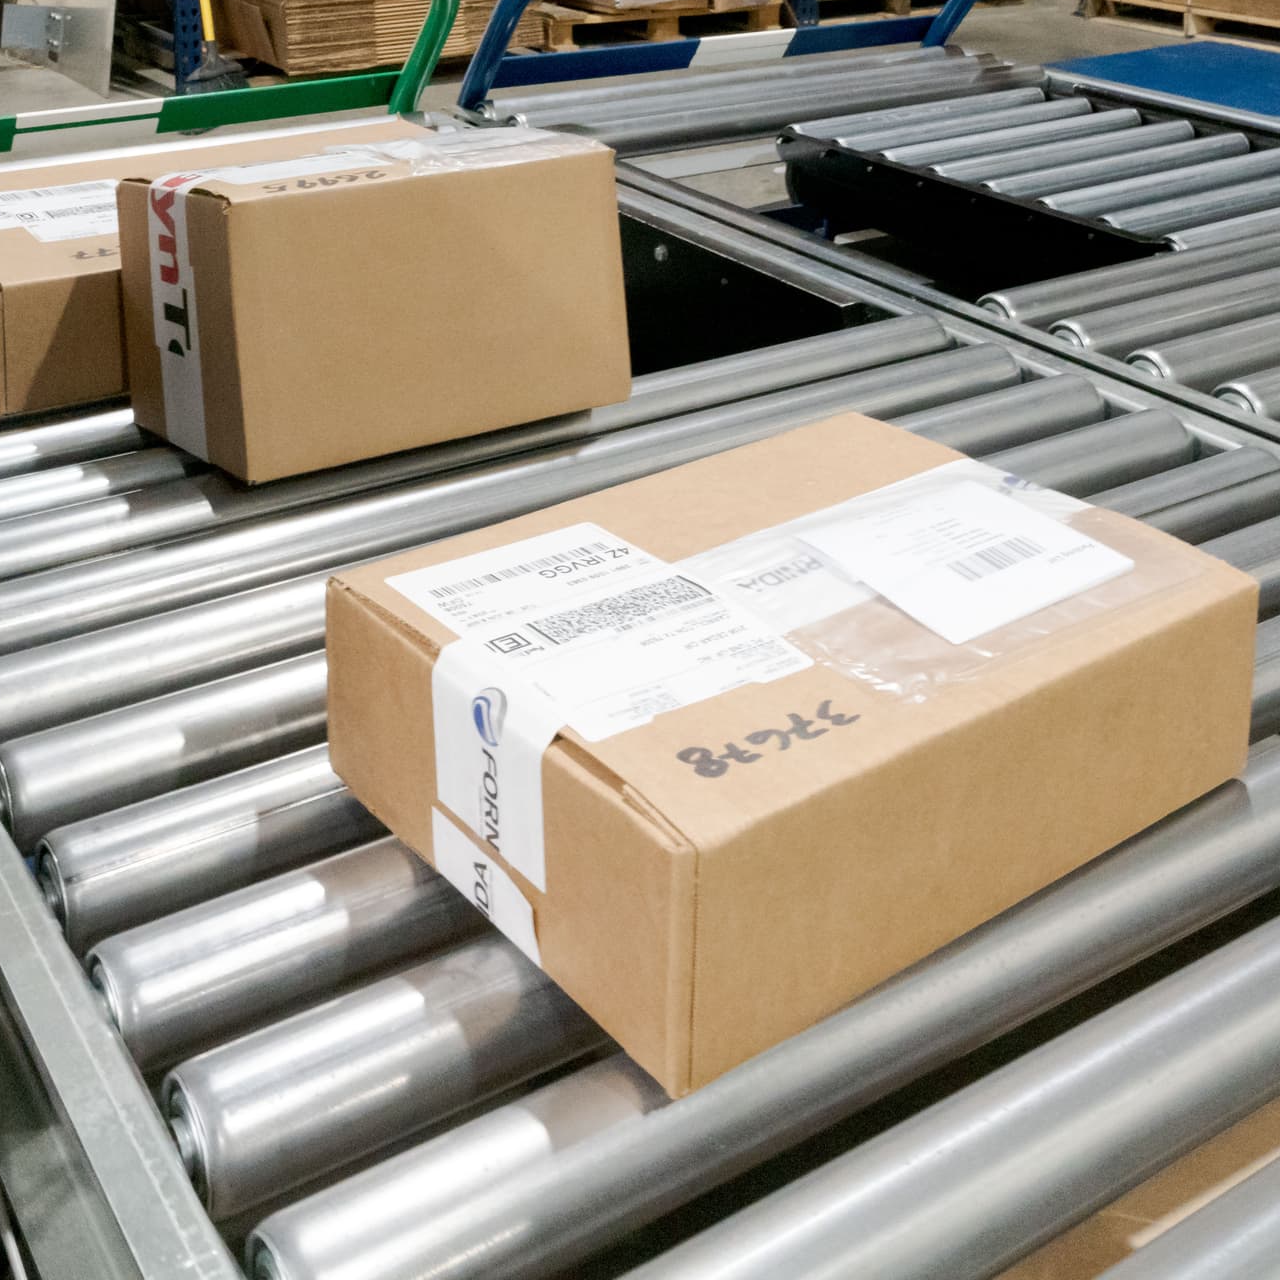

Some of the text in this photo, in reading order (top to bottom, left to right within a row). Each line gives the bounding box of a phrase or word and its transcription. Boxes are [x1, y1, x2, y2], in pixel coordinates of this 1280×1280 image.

[605, 546, 630, 559] 4Z
[538, 554, 607, 579] IRVGG
[676, 699, 862, 779] 37678
